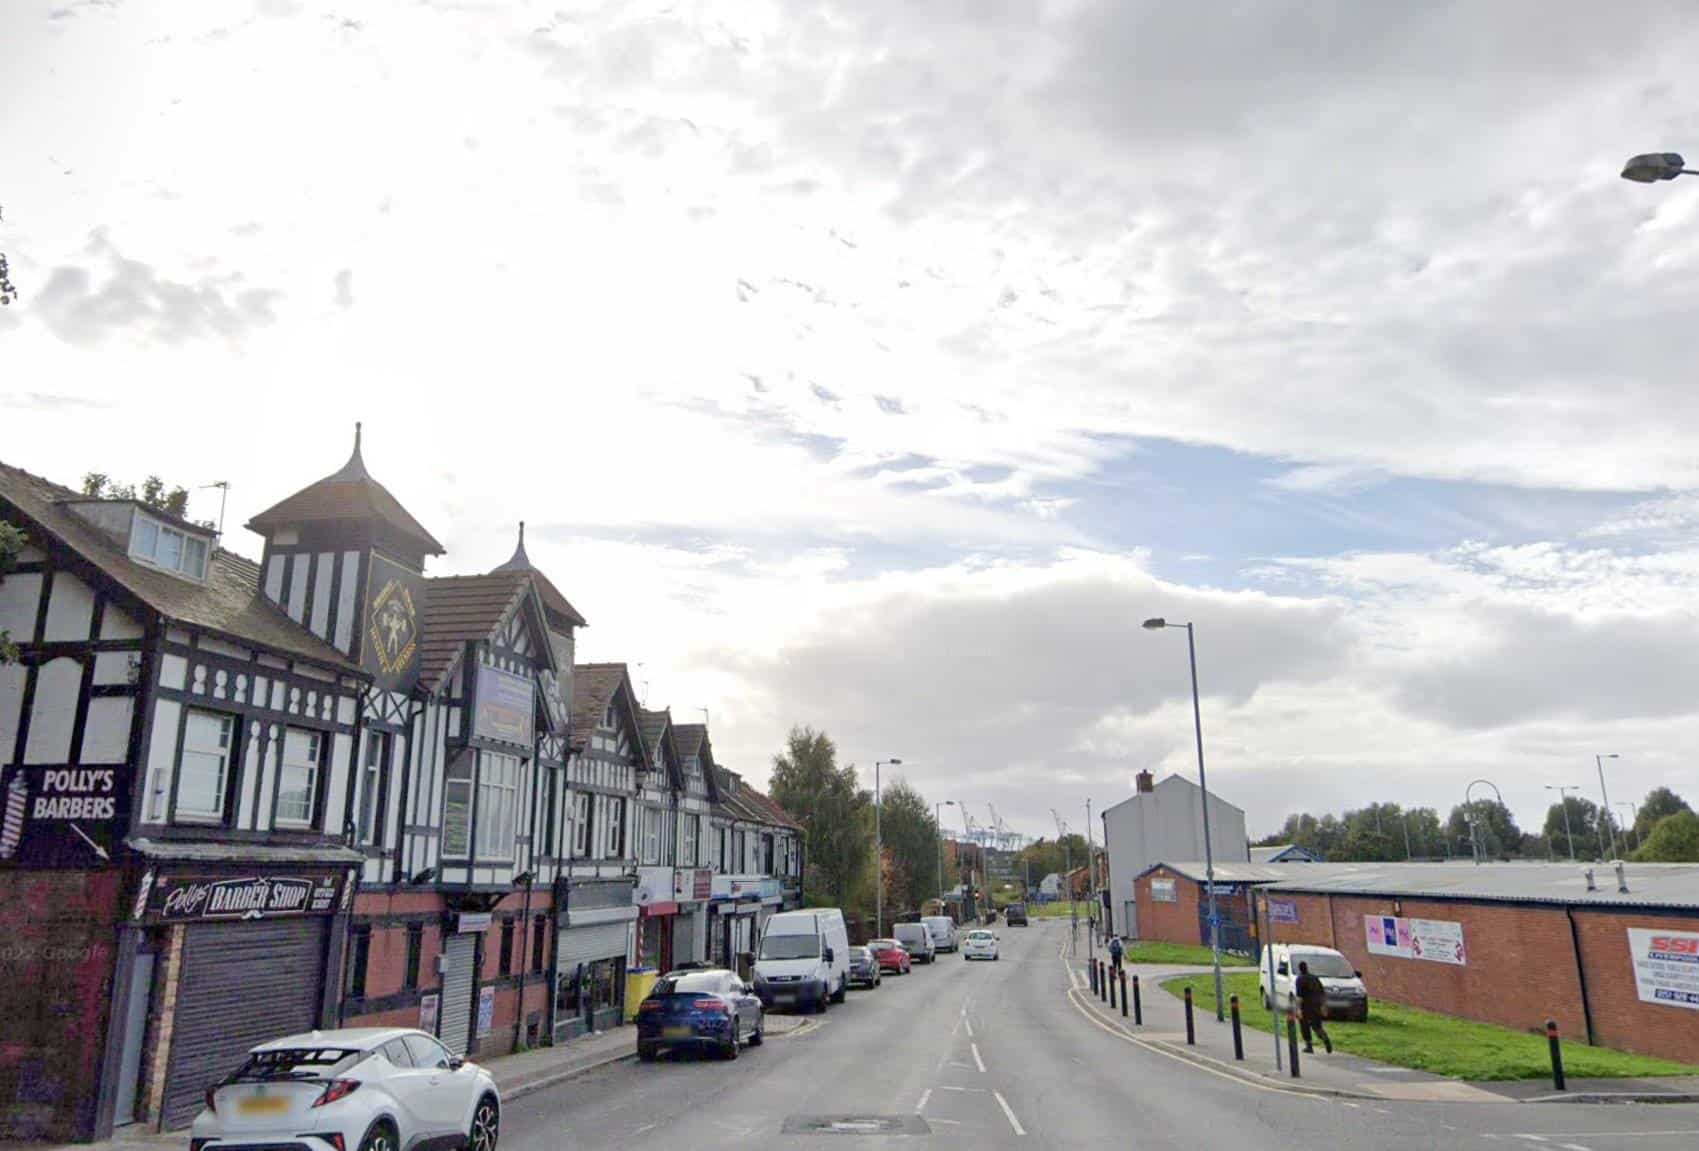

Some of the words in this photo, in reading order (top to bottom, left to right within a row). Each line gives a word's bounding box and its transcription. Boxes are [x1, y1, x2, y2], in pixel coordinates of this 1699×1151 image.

[43, 770, 114, 791] POLLY'S
[33, 797, 115, 819] BARBERS
[210, 885, 269, 910] BARBER
[270, 883, 306, 907] SHOP
